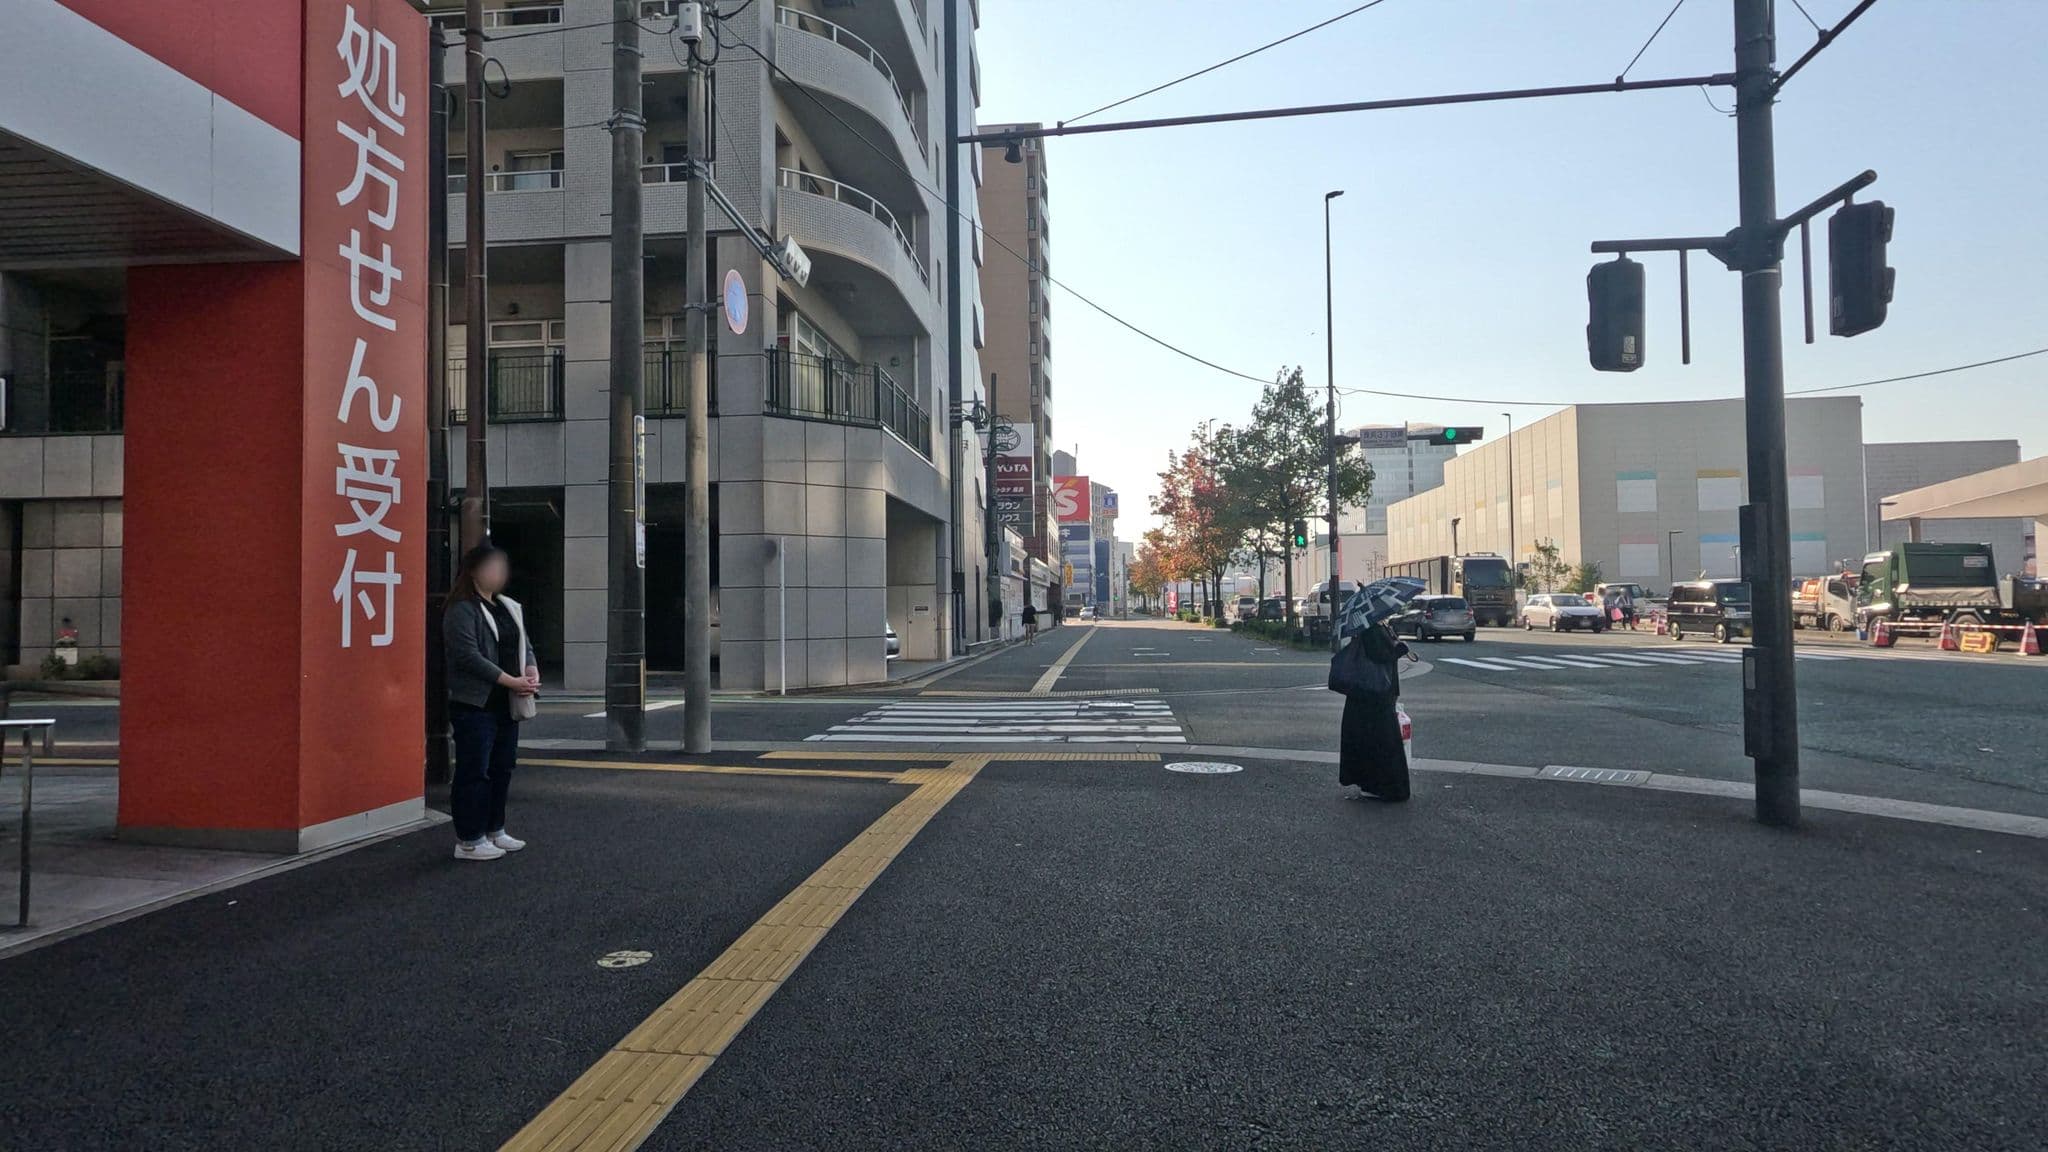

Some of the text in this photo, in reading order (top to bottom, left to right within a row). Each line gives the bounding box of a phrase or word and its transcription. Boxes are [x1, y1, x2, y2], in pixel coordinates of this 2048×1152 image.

[333, 4, 406, 648] 処方せん受付
[997, 502, 1020, 510] ラウン
[997, 513, 1020, 521] リウス
